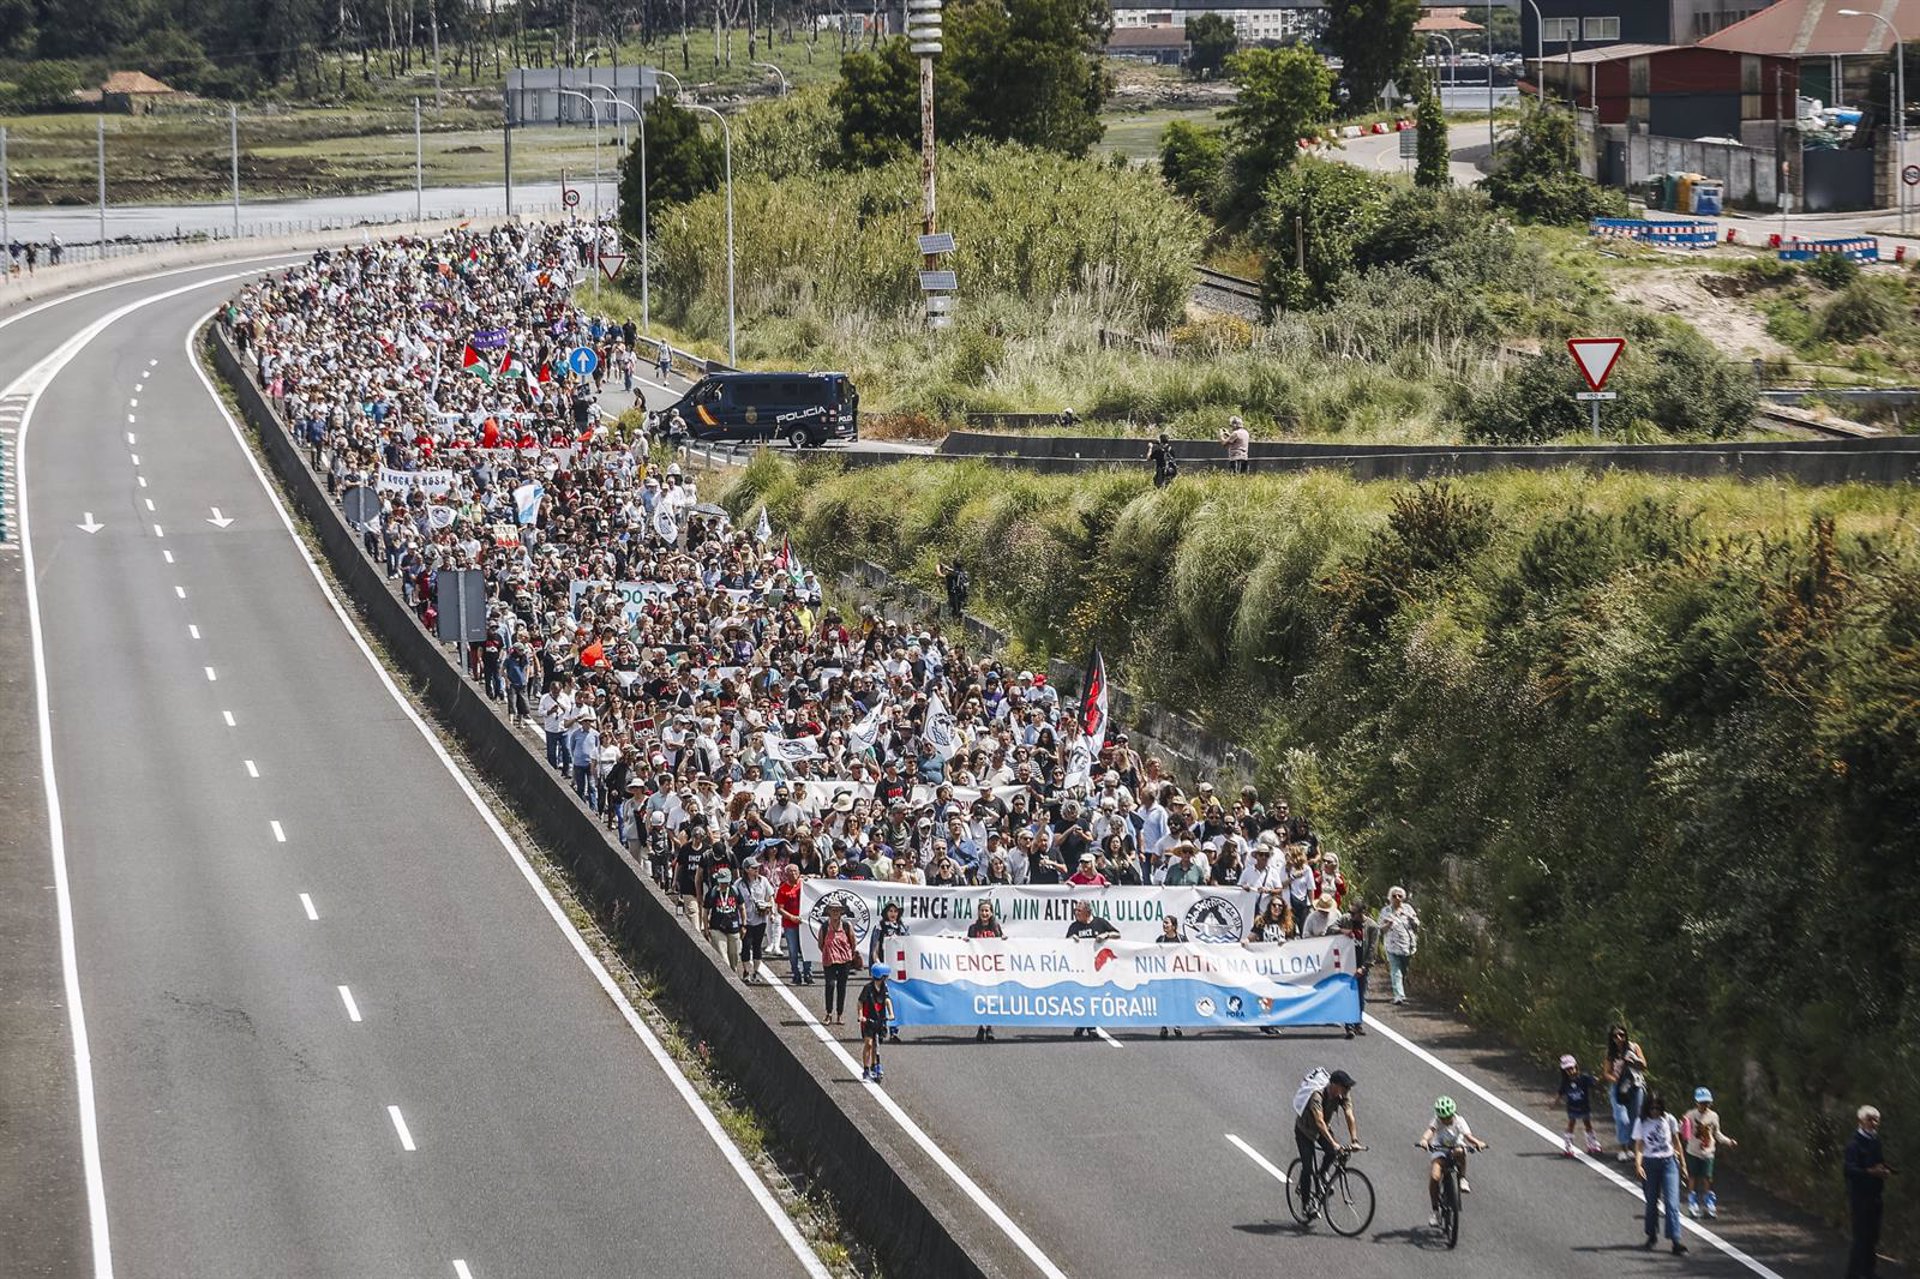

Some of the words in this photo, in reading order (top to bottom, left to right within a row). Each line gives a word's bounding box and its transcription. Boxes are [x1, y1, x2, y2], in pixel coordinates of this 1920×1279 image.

[776, 405, 827, 424] POLICÍA
[877, 895, 904, 917] NN
[910, 897, 948, 919] ENCE
[954, 898, 972, 919] NA
[1013, 898, 1039, 920] NIN
[1045, 899, 1078, 920] ALTR
[1091, 900, 1111, 921] NA
[1116, 900, 1164, 921] ULLOA
[920, 952, 950, 970] NIN
[956, 954, 1005, 972] ENCE
[1010, 954, 1035, 972] NA
[1041, 950, 1085, 973] RÍA...
[1136, 955, 1166, 973] NIN
[1227, 958, 1252, 975] NA
[1256, 954, 1322, 976] ULLOA!
[974, 995, 1085, 1016] CELULOSAS
[1091, 992, 1157, 1017] FÓRA!!!
